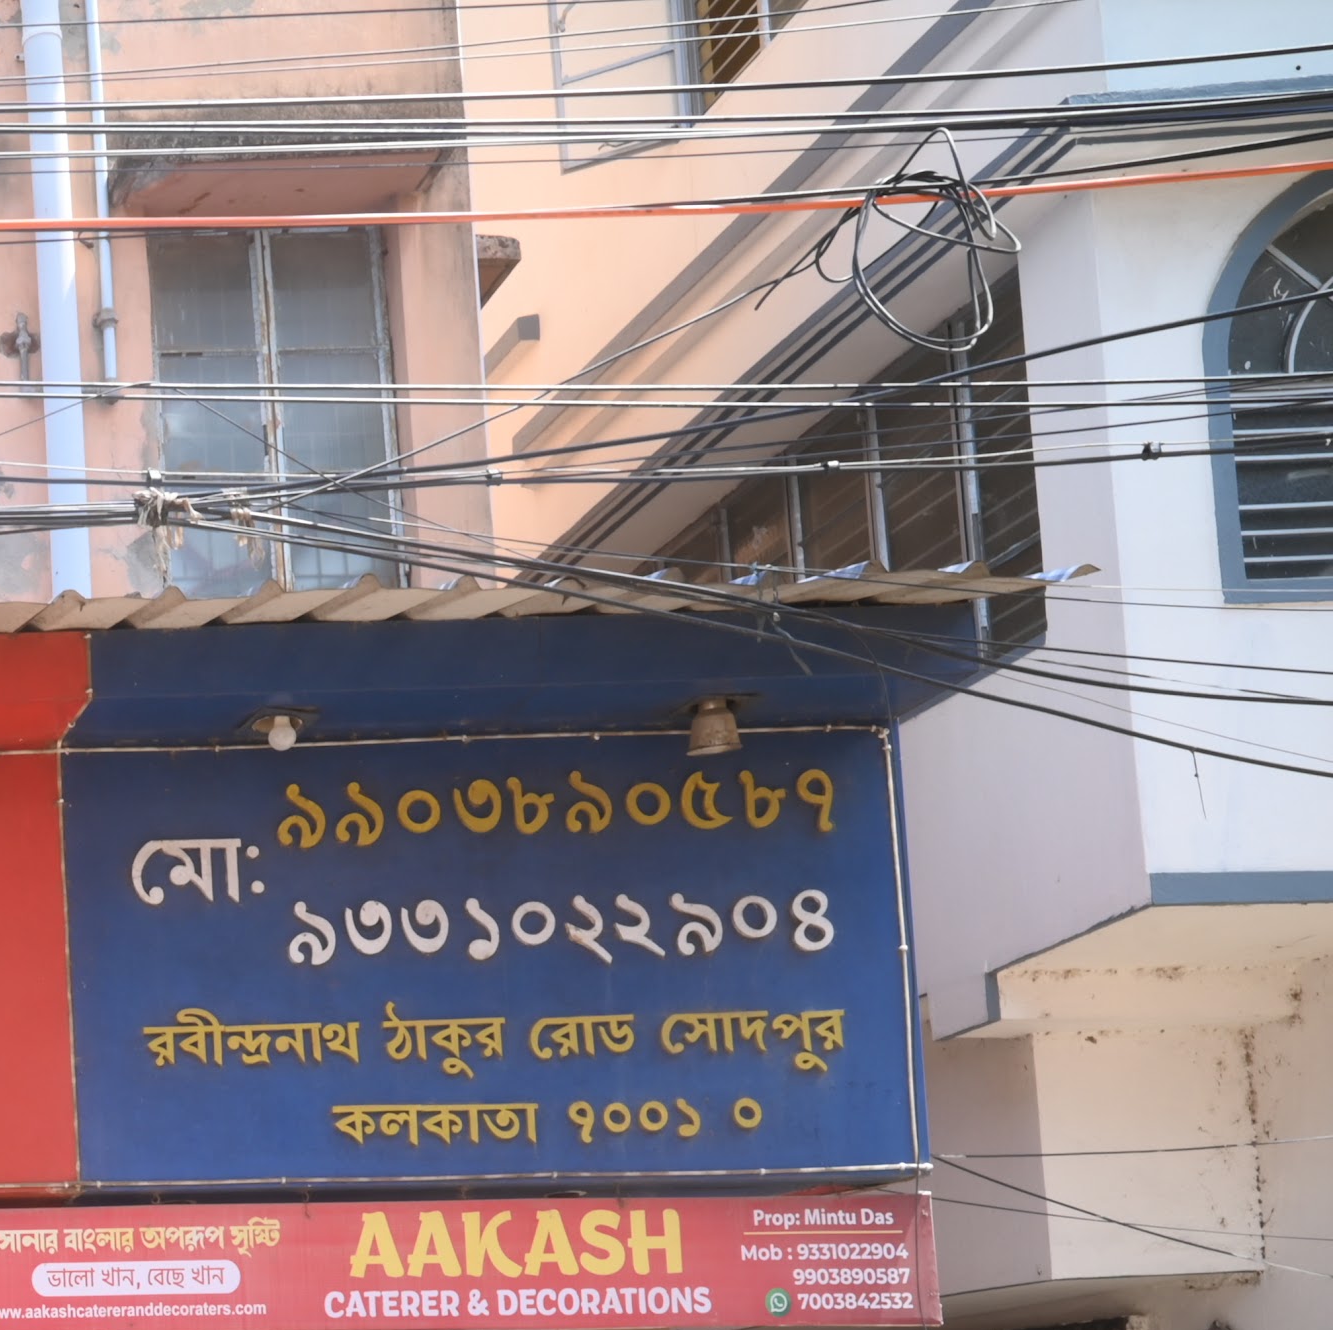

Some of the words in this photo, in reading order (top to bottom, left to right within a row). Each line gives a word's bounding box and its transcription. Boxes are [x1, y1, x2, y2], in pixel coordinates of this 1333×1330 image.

[276, 768, 836, 851] ৯৯০৩৮৯০৫৮৭
[288, 889, 835, 966] ৯৩৩১০২২৯০৪
[144, 1007, 361, 1068] রবীন্দ্রনাথ
[382, 1001, 504, 1079] ঠাকুর
[529, 1012, 636, 1060] রোড
[660, 1008, 845, 1073] সোদপুর
[333, 1102, 539, 1147] কলকাতা
[63, 1228, 135, 1254] বাংলার
[140, 1225, 225, 1252] অপরূপ
[229, 1216, 280, 1258] সৃষ্টি
[753, 1208, 800, 1230] Prop:
[804, 1208, 856, 1227] Mintu
[861, 1208, 894, 1227] Das
[349, 1208, 683, 1279] AAKASH
[797, 1243, 909, 1261] 9331022904
[46, 1265, 95, 1290] ভালো
[101, 1266, 141, 1291] খান,
[147, 1266, 185, 1289] বেছে
[190, 1265, 225, 1287] খান
[793, 1267, 911, 1286] 9903890587
[324, 1288, 461, 1319] CATERER
[466, 1289, 490, 1317] &
[496, 1285, 712, 1317] DECORATIONS
[797, 1293, 914, 1311] 7003842532
